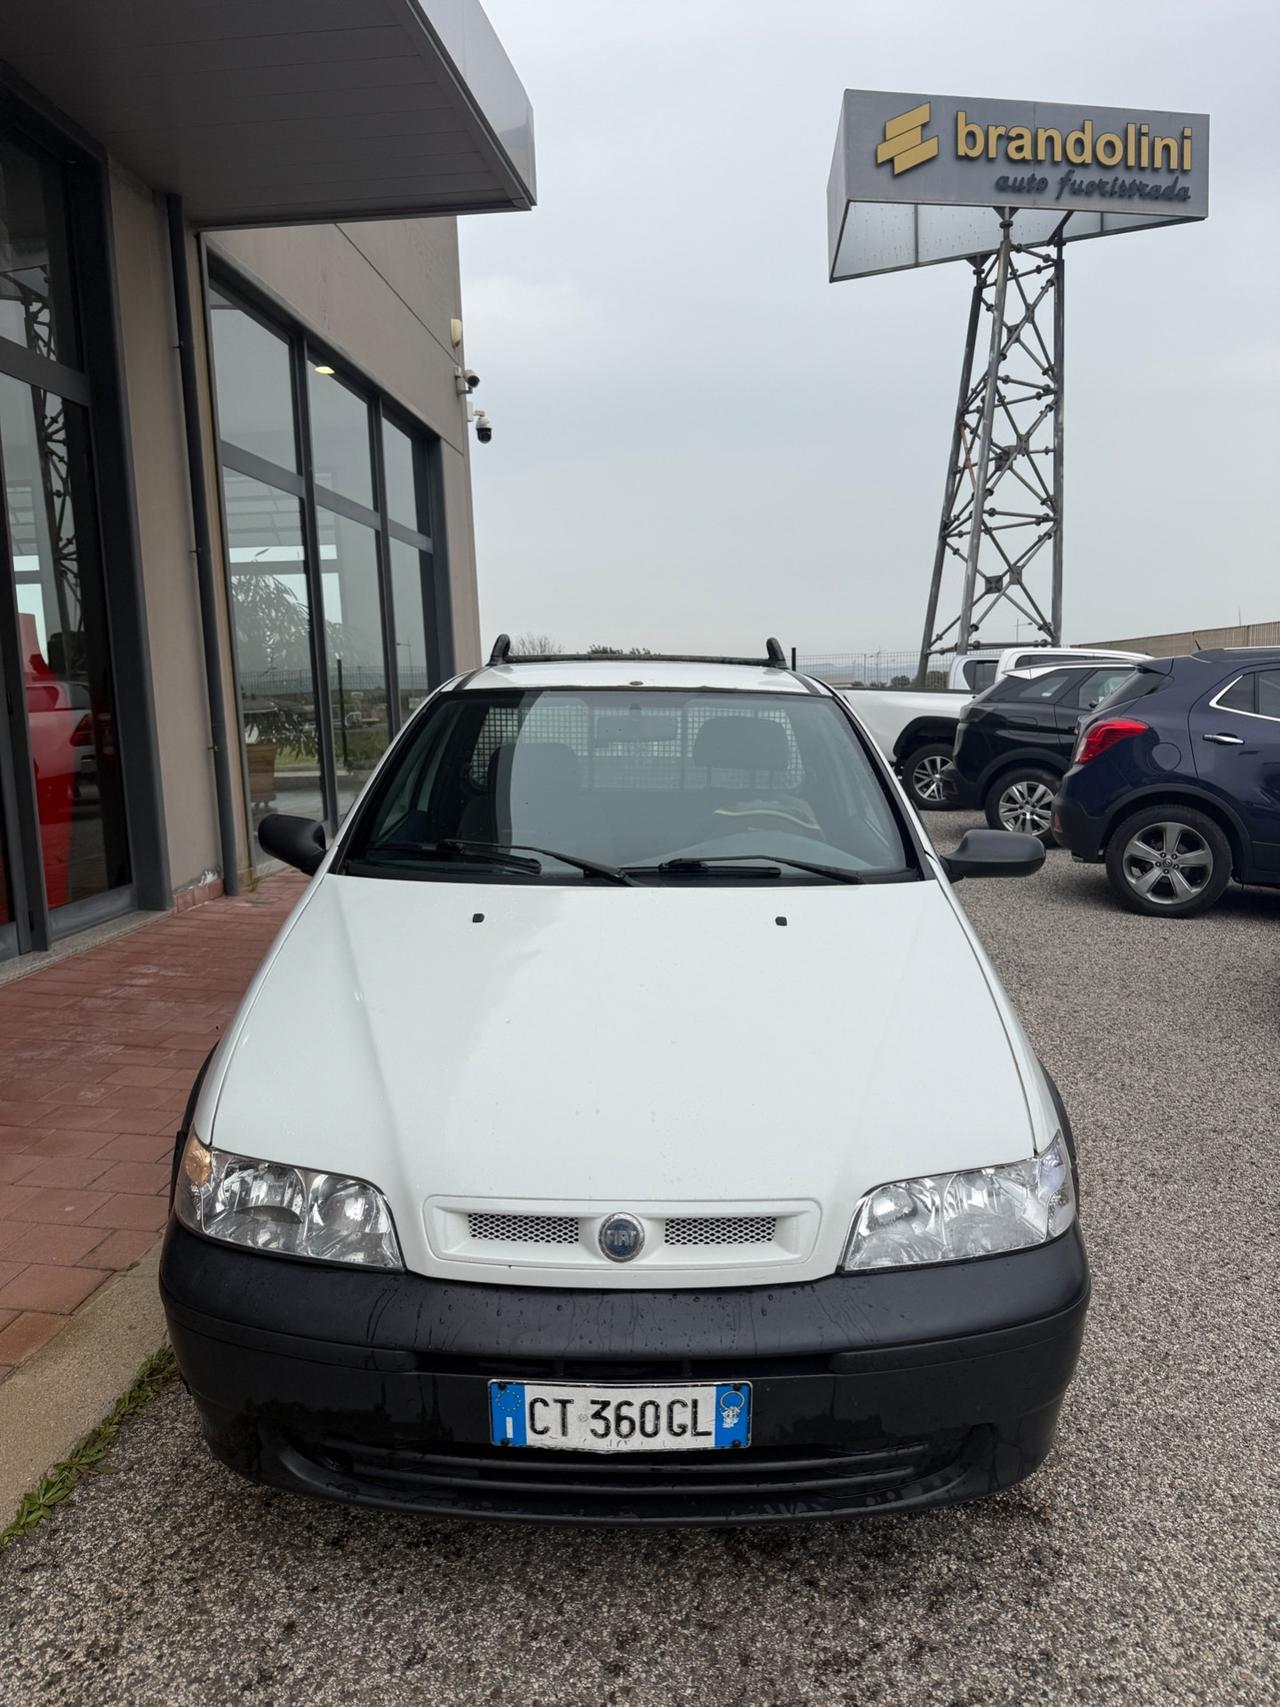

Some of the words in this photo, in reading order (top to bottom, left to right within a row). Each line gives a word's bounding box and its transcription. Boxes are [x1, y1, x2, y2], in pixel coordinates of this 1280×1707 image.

[956, 111, 1193, 171] brandolini
[995, 174, 1048, 194] auto
[1055, 169, 1192, 202] fuoristrada
[529, 1397, 575, 1437] CT
[589, 1398, 713, 1439] 360GL
